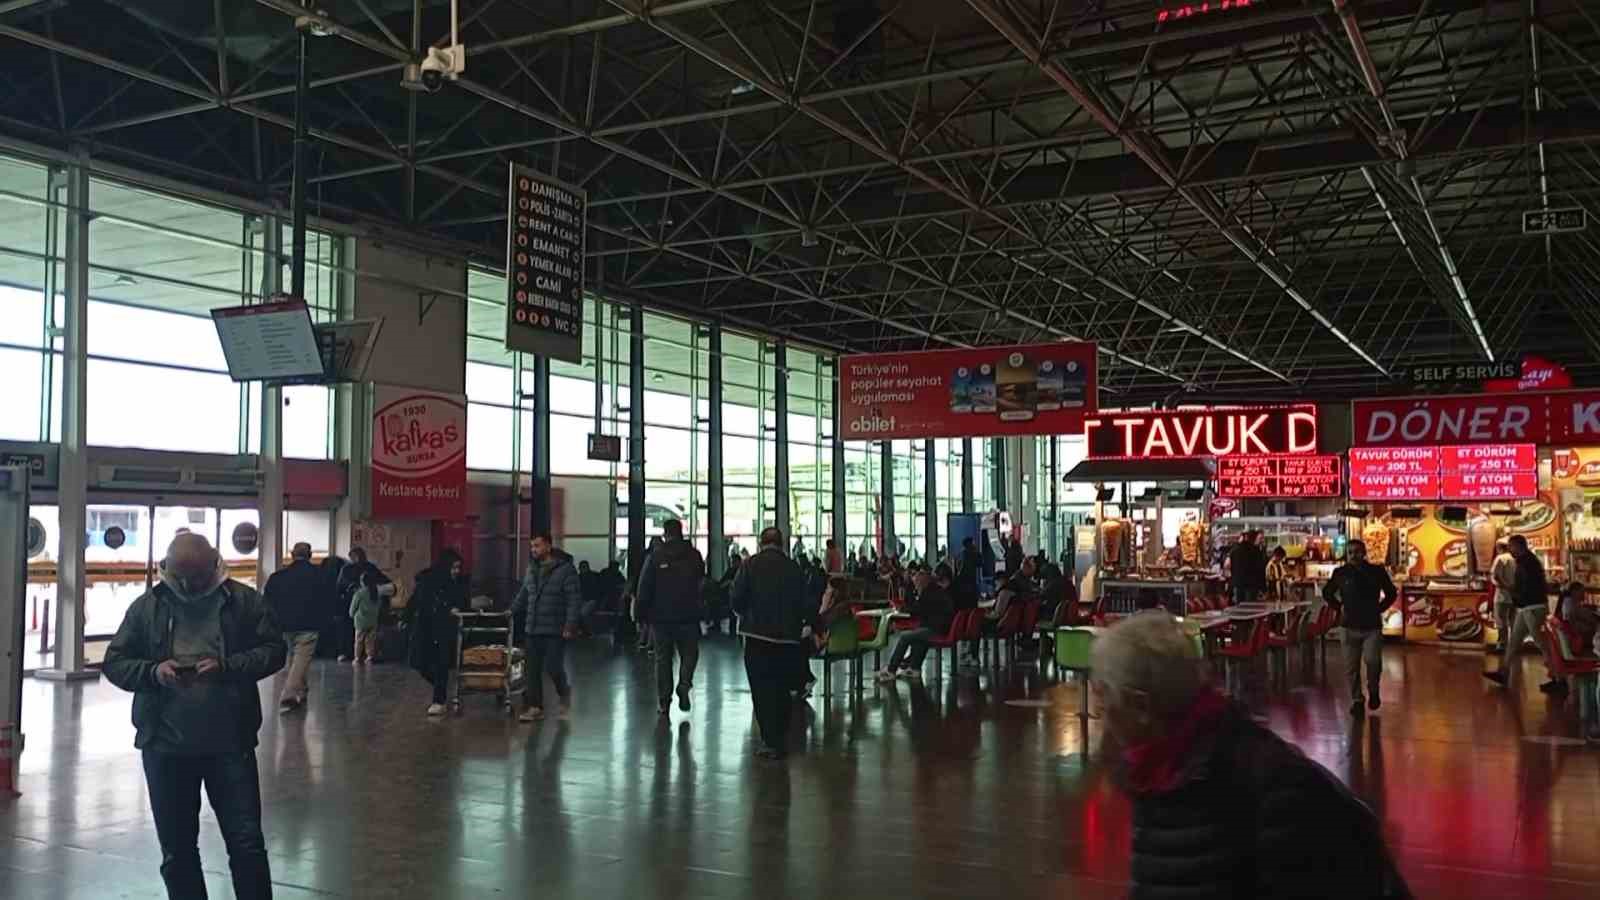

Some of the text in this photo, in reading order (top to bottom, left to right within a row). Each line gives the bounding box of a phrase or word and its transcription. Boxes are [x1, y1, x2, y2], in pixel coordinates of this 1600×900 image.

[531, 181, 573, 206] DANIŞMA
[529, 218, 552, 234] RENT
[533, 238, 570, 259] EMANET
[555, 317, 569, 332] WC
[850, 362, 909, 377] Türkiye'nin
[1414, 363, 1515, 381] SELF SERVİS
[850, 375, 943, 393] popüler seyahat
[850, 391, 915, 405] uygulaması
[850, 415, 895, 433] obilet
[1366, 401, 1530, 442] DÖNER
[381, 415, 458, 456] kafkas
[1113, 414, 1270, 456] TAVUK
[1356, 448, 1433, 460] TAVUK DÜRÜM
[1457, 447, 1517, 457] ET DÜRÜM
[1262, 466, 1273, 475] TL
[1323, 464, 1334, 473] TL
[1408, 461, 1422, 470] TL
[1503, 459, 1518, 468] TL
[1360, 474, 1428, 486] TAVUK ATOM
[1463, 473, 1513, 484] ET ATOM
[379, 479, 460, 501] Kestane Şekeri
[1261, 485, 1272, 494] TL
[1320, 484, 1333, 493] TL
[1407, 487, 1421, 496] TL
[1503, 486, 1516, 495] TL
